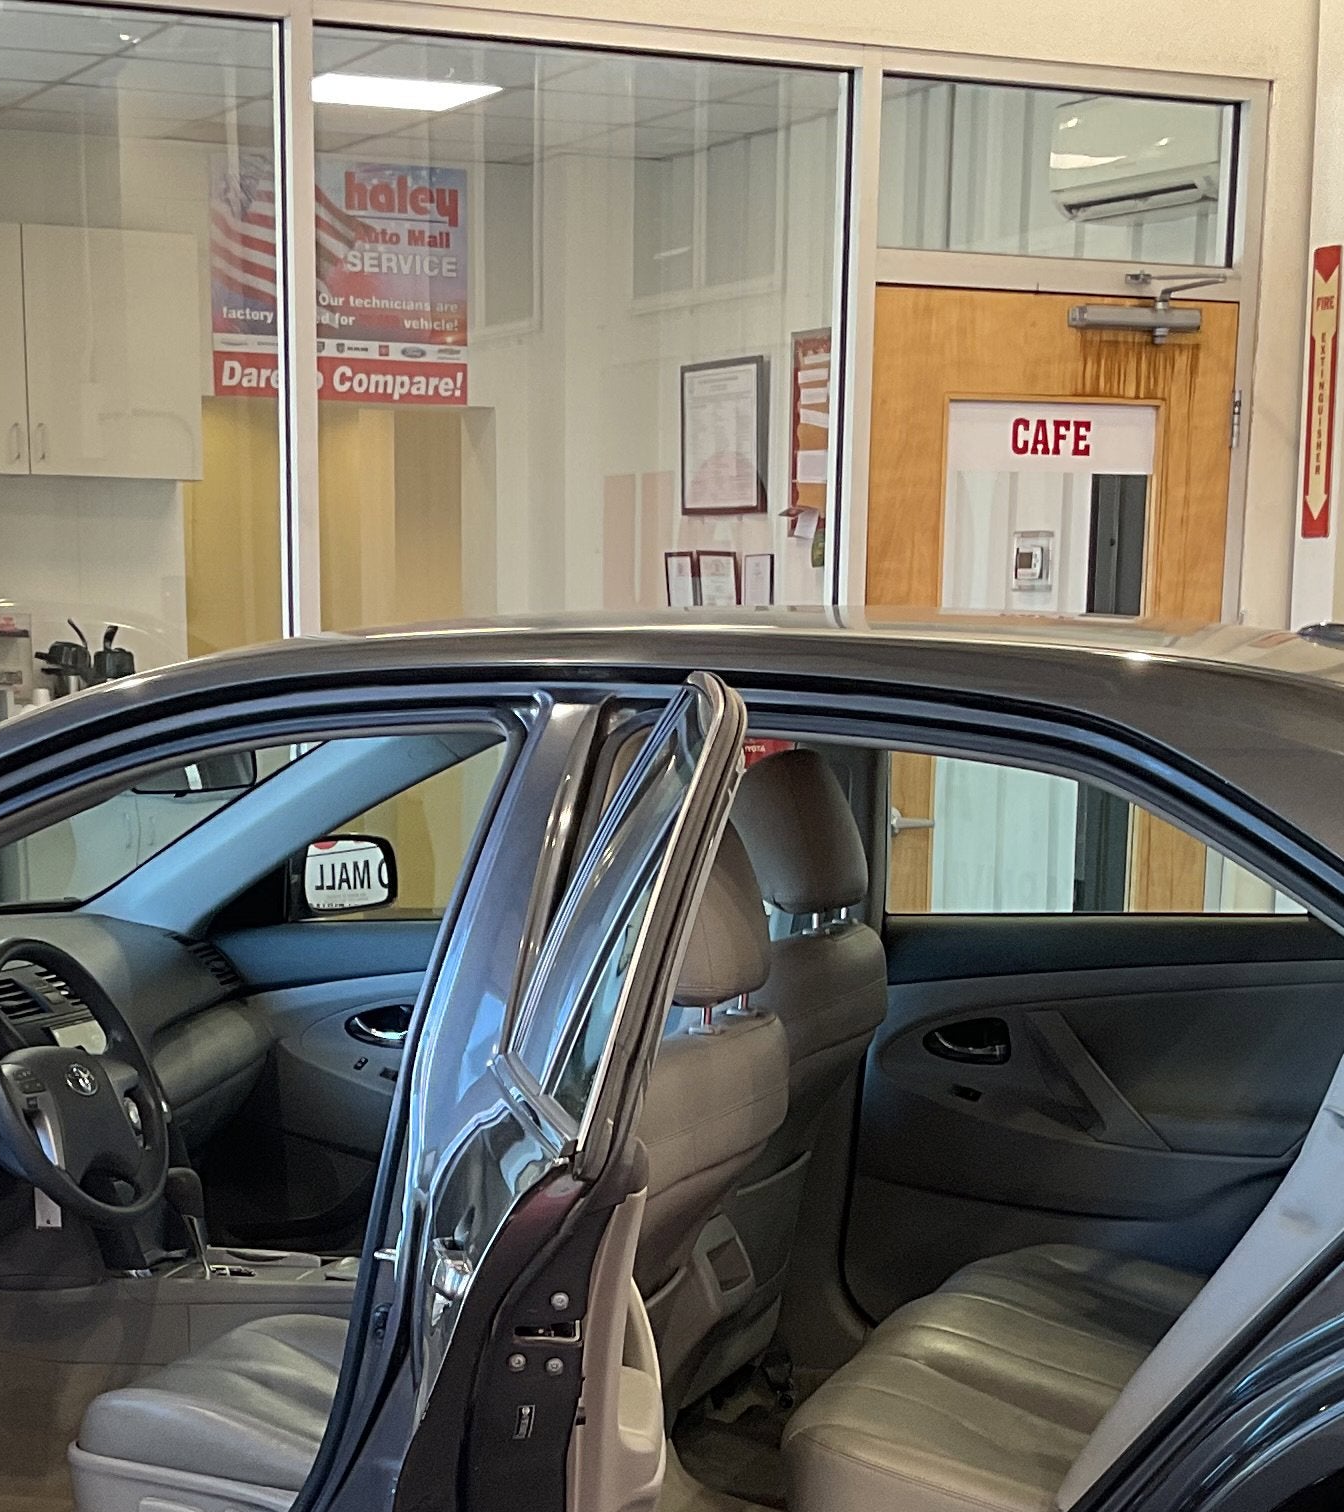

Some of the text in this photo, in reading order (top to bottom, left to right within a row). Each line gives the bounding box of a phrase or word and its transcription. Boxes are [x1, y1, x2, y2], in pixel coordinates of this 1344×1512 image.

[344, 171, 458, 227] haley
[356, 228, 450, 248] Auto Mall
[346, 251, 457, 277] SERVICE
[318, 293, 458, 313] Our technicians are
[1316, 296, 1334, 312] FIRE
[222, 306, 274, 324] factory
[334, 312, 356, 325] for
[404, 317, 458, 331] vehicle!
[333, 365, 463, 400] Compare!
[1314, 332, 1327, 475] EXTINGUISHER
[1011, 417, 1092, 456] CAFE
